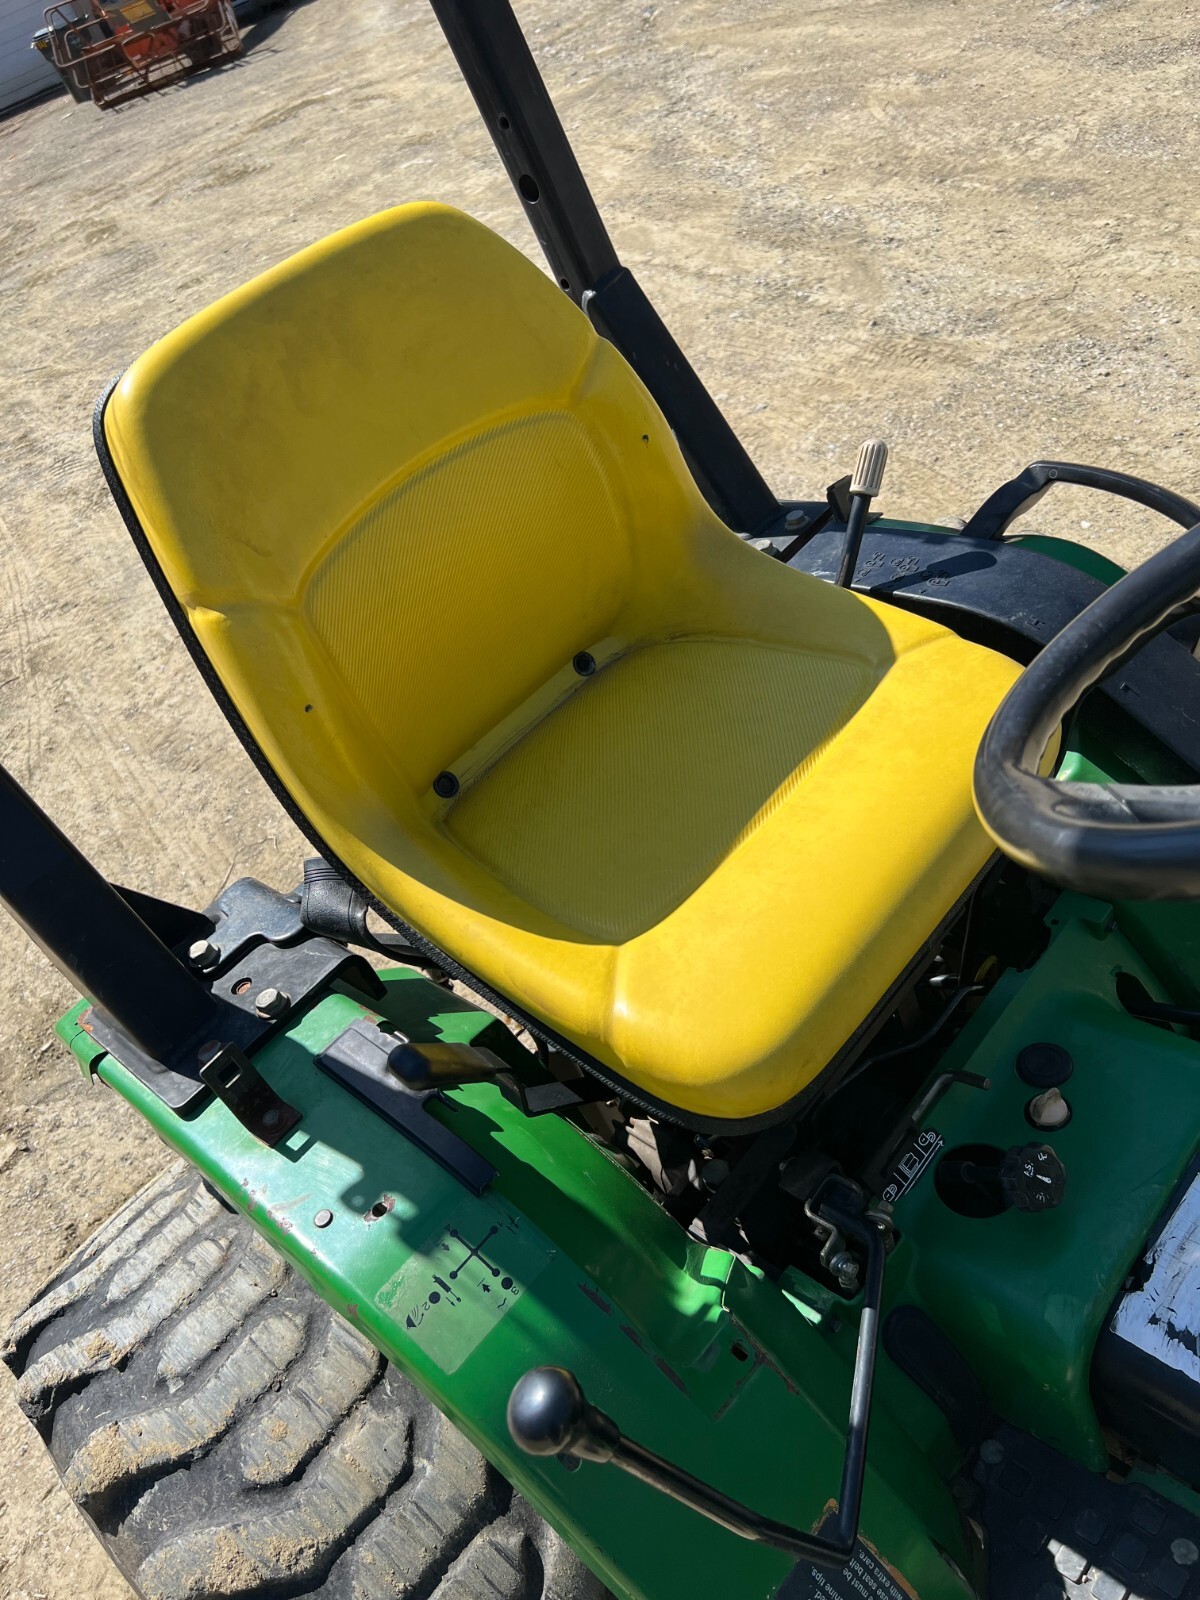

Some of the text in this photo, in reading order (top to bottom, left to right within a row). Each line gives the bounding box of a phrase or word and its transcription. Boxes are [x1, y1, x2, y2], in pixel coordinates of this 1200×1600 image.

[510, 1286, 520, 1295] 3
[421, 1302, 430, 1311] 2
[849, 1558, 864, 1576] belt
[859, 1549, 903, 1600] with extra care.
[811, 1566, 826, 1587] tips.
[842, 1567, 868, 1598] must be
[862, 1572, 877, 1590] seat
